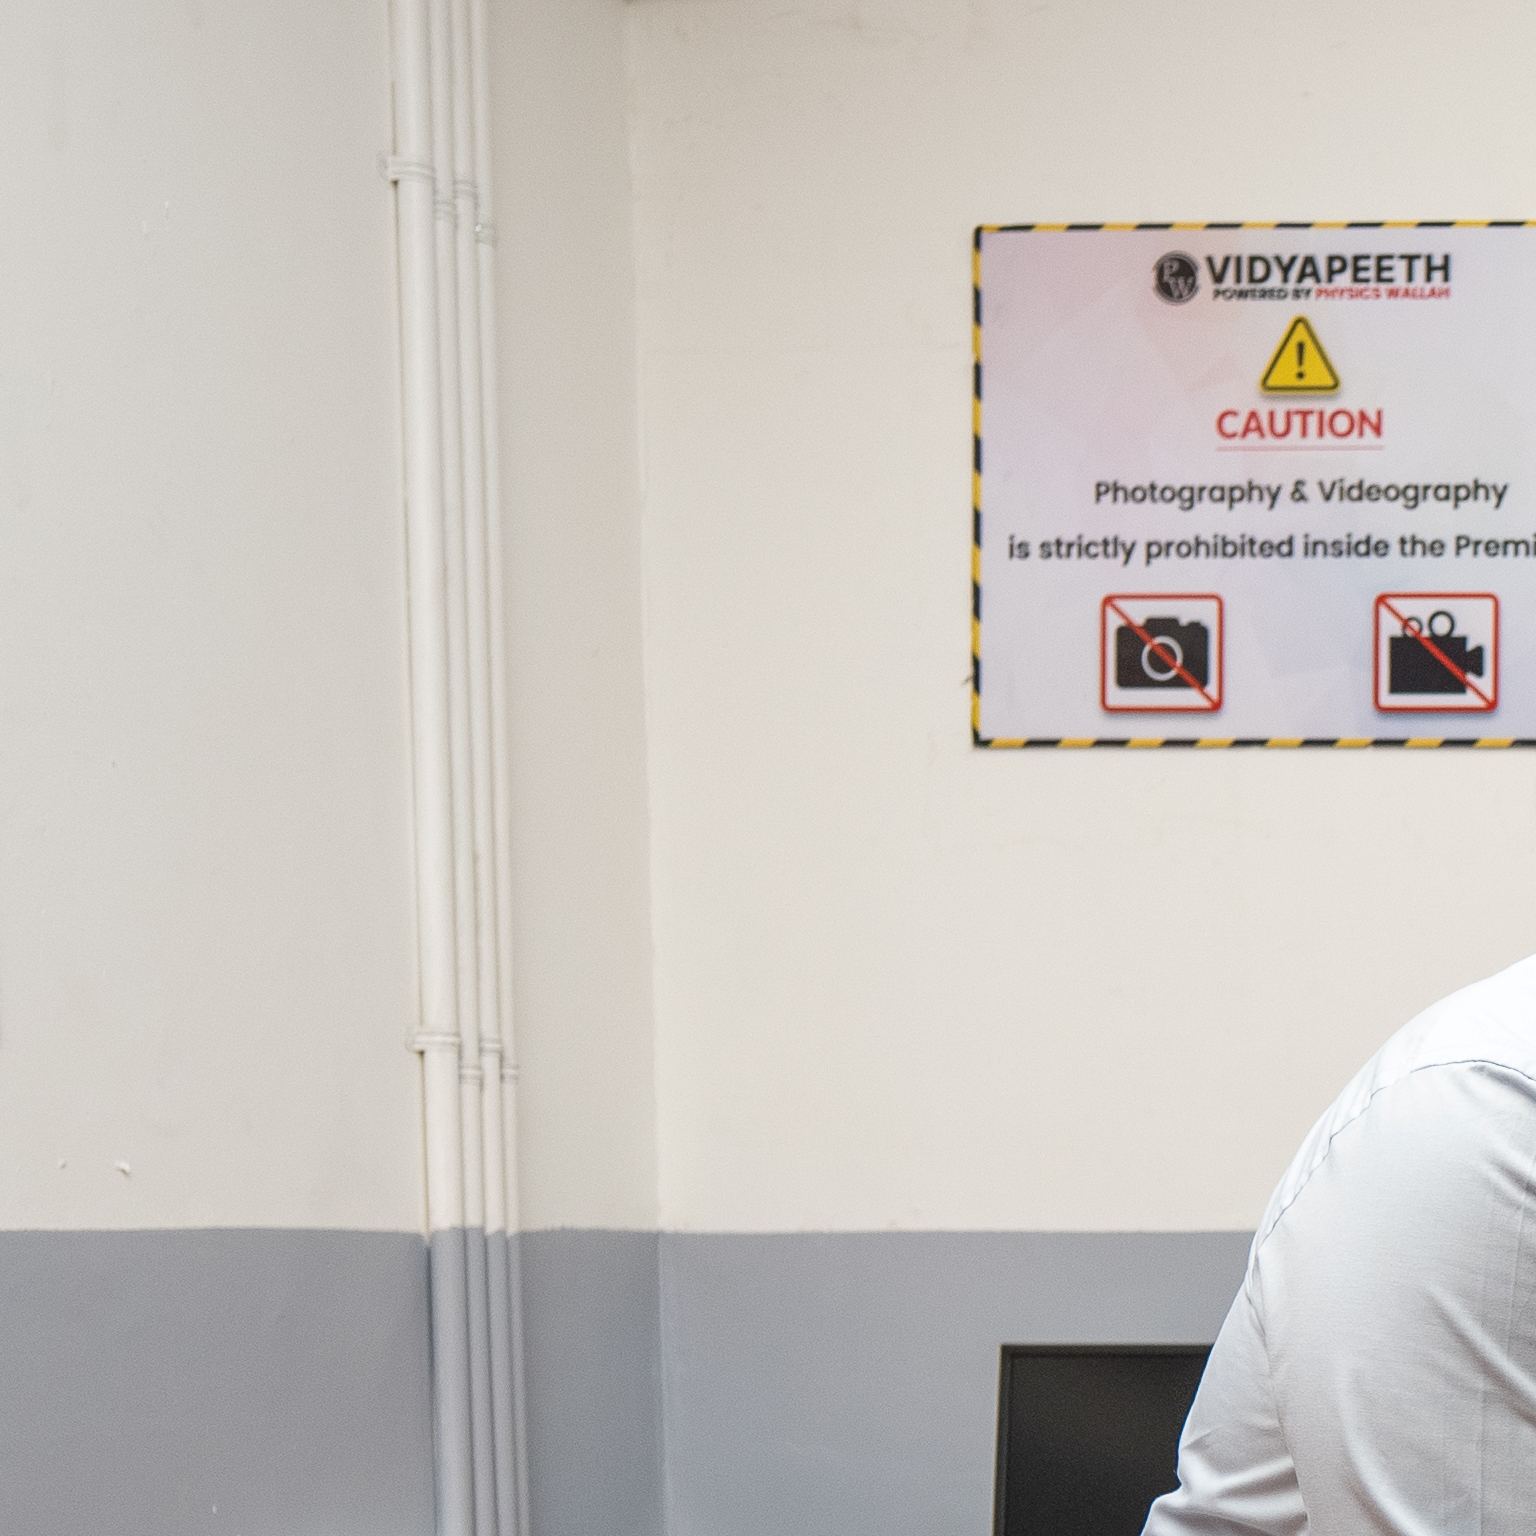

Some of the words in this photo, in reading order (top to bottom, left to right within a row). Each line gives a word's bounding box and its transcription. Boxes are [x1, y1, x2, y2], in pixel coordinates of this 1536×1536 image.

[1206, 254, 1450, 284] VIDYAPEETH
[1213, 288, 1287, 300] POWERED
[1291, 288, 1312, 300] BY
[1315, 287, 1381, 299] PHYSICS
[1385, 287, 1451, 299] WALLAH
[1215, 407, 1383, 439] CAUTION
[1094, 480, 1282, 512] Photography
[1290, 480, 1307, 502] &
[1318, 478, 1508, 511] Videography
[1008, 534, 1030, 560] is
[1039, 534, 1137, 567] strictly
[1145, 534, 1294, 567] prohibited
[1303, 533, 1389, 558] inside
[1398, 534, 1445, 558] the
